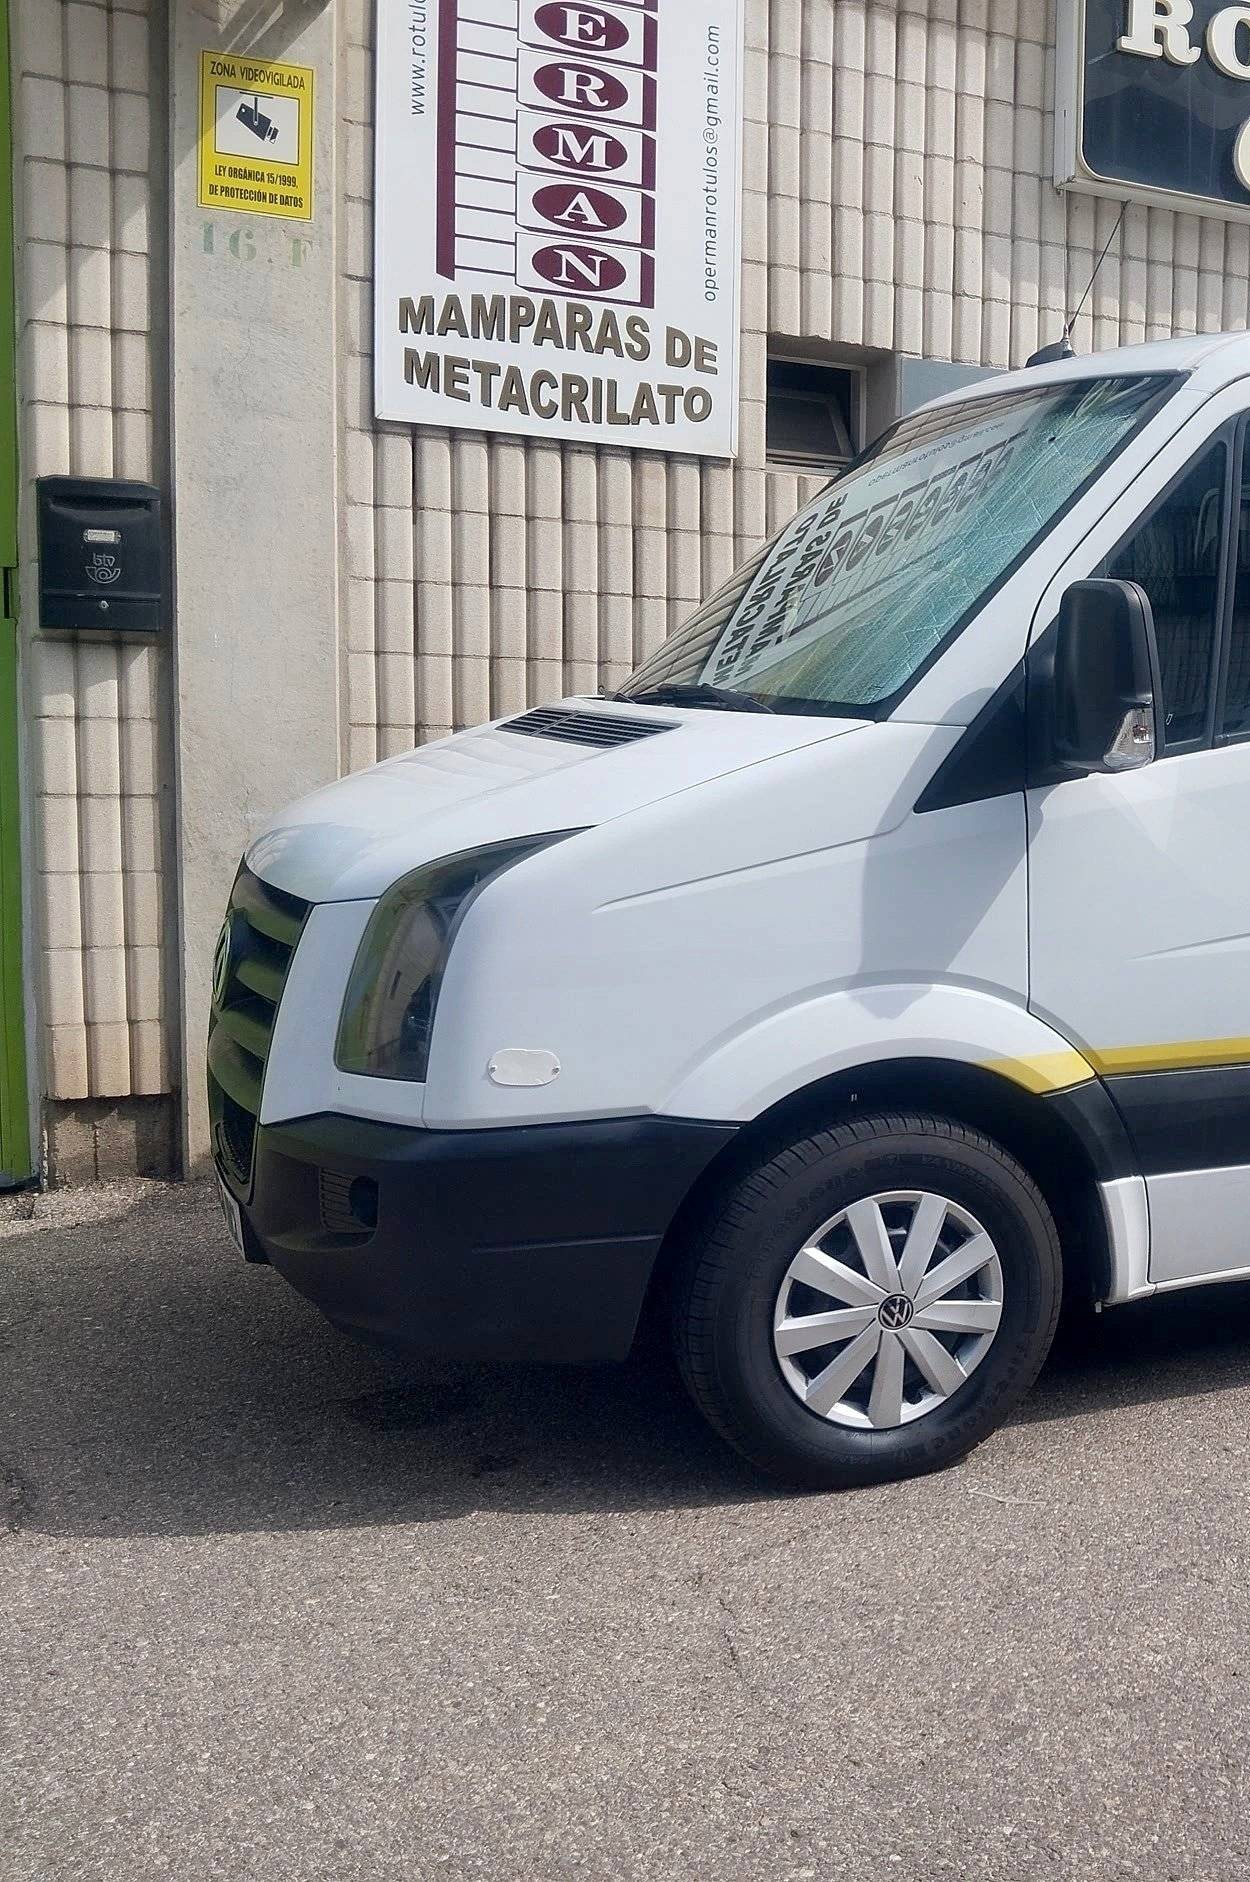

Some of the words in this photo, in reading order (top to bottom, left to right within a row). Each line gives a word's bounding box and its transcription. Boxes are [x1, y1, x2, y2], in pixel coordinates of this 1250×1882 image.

[210, 61, 237, 78] ZONA
[240, 66, 306, 91] VIDEOVIGILADA
[408, 0, 426, 115] www.rotul
[208, 183, 219, 196] DE
[219, 185, 267, 203] PROTECCIÓN
[268, 192, 279, 205] DE
[279, 194, 304, 208] DATOS
[214, 164, 228, 177] LEY
[228, 165, 265, 184] ORGÁNICA
[702, 24, 722, 302] opermanrotulos@gmail.com
[398, 293, 652, 362] MAMPARAS
[665, 325, 719, 376] DE
[403, 346, 714, 425] METACRILATO
